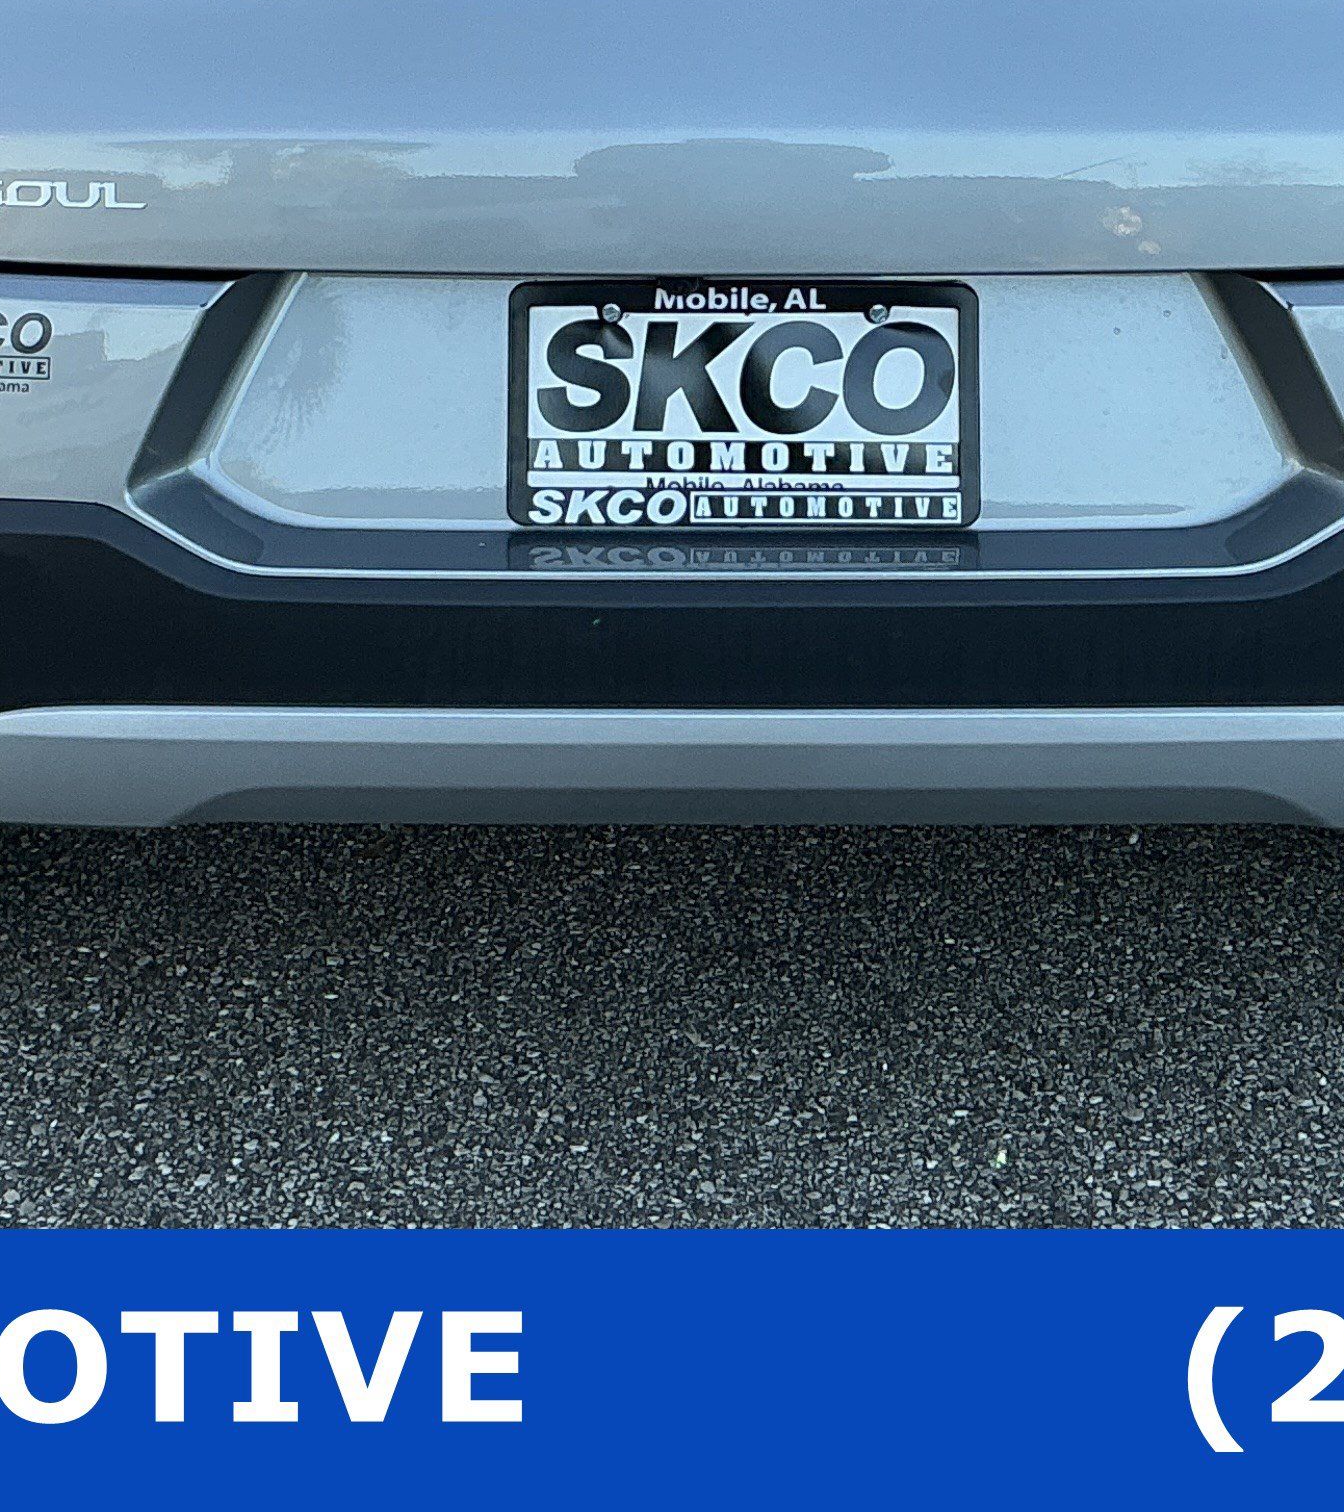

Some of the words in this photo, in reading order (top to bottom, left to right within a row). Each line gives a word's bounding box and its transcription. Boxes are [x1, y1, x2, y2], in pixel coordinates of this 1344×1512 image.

[654, 287, 778, 313] Mobile,
[783, 287, 827, 310] AL
[536, 318, 956, 436] SKCO
[533, 440, 954, 474] AUTOMOTIVE
[528, 489, 688, 525] SKCO
[695, 495, 958, 519] AUTOMOTIVE
